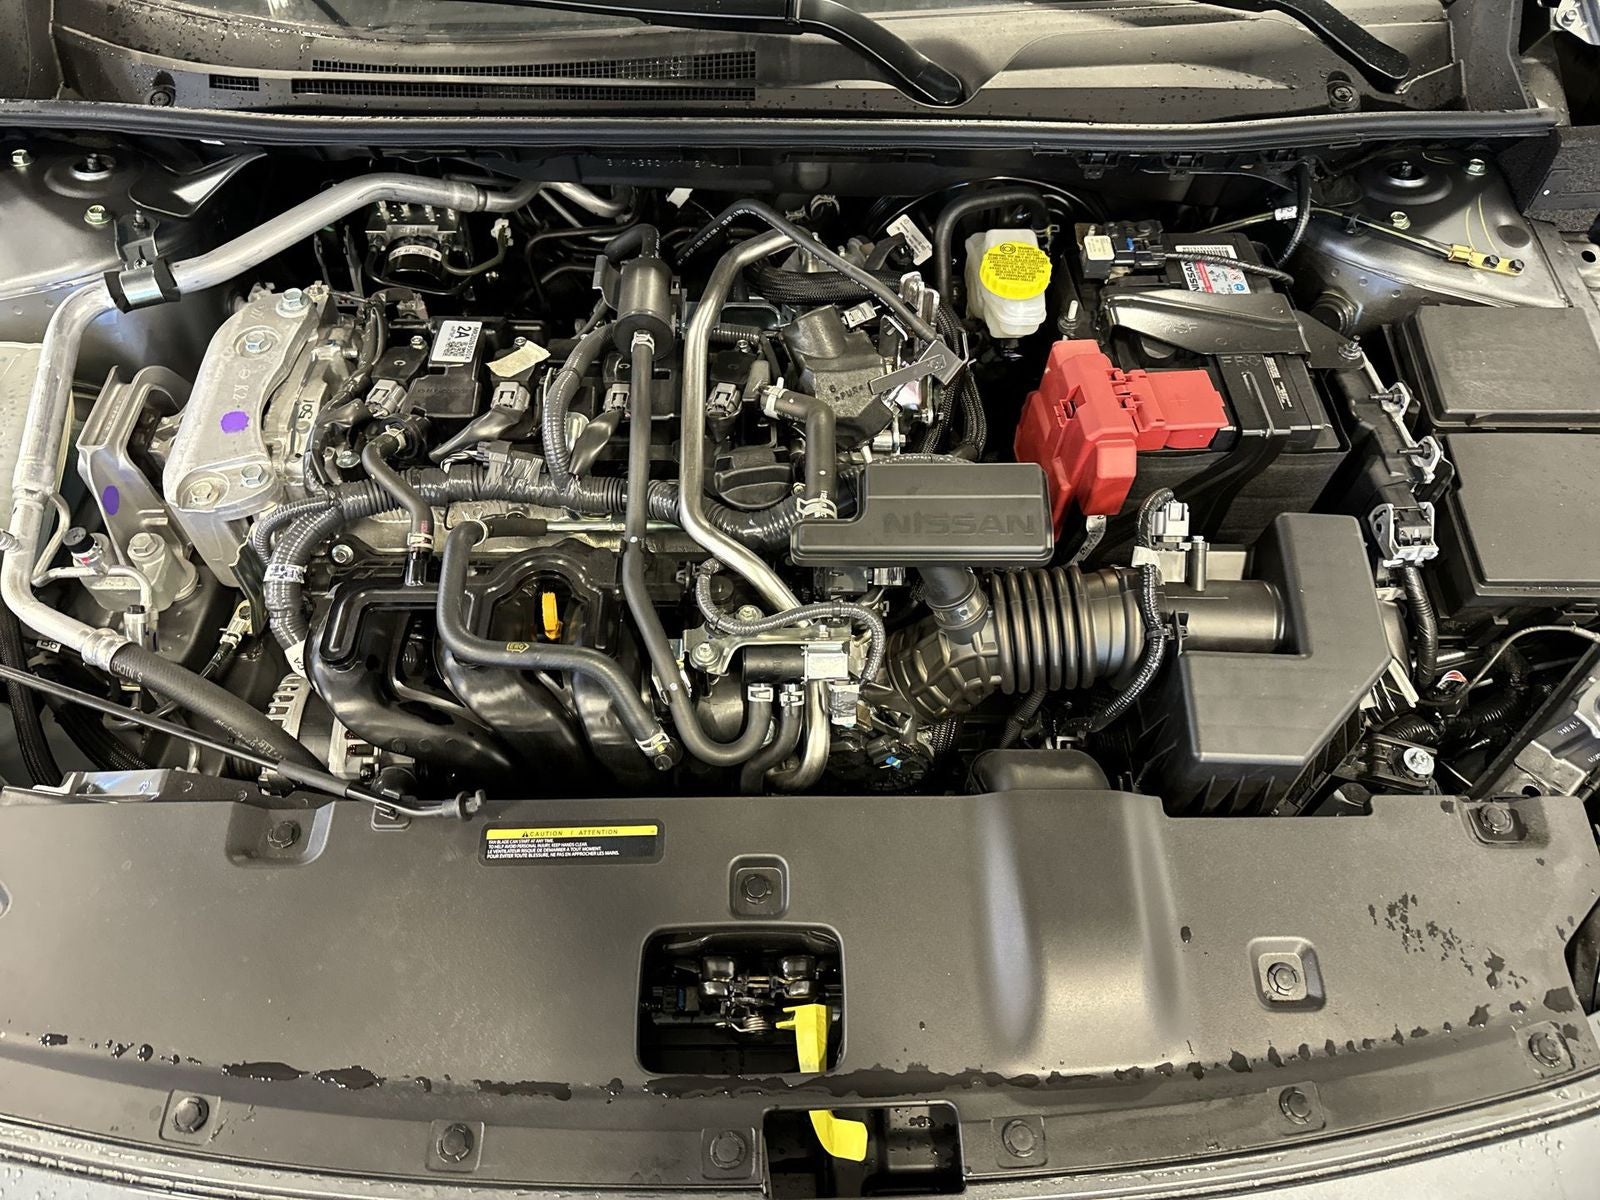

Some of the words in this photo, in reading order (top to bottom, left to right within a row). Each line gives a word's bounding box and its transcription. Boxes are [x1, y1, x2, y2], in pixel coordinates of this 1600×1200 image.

[1183, 260, 1200, 292] NISSAN
[455, 325, 472, 339] 2A
[882, 511, 1035, 536] NISSAN
